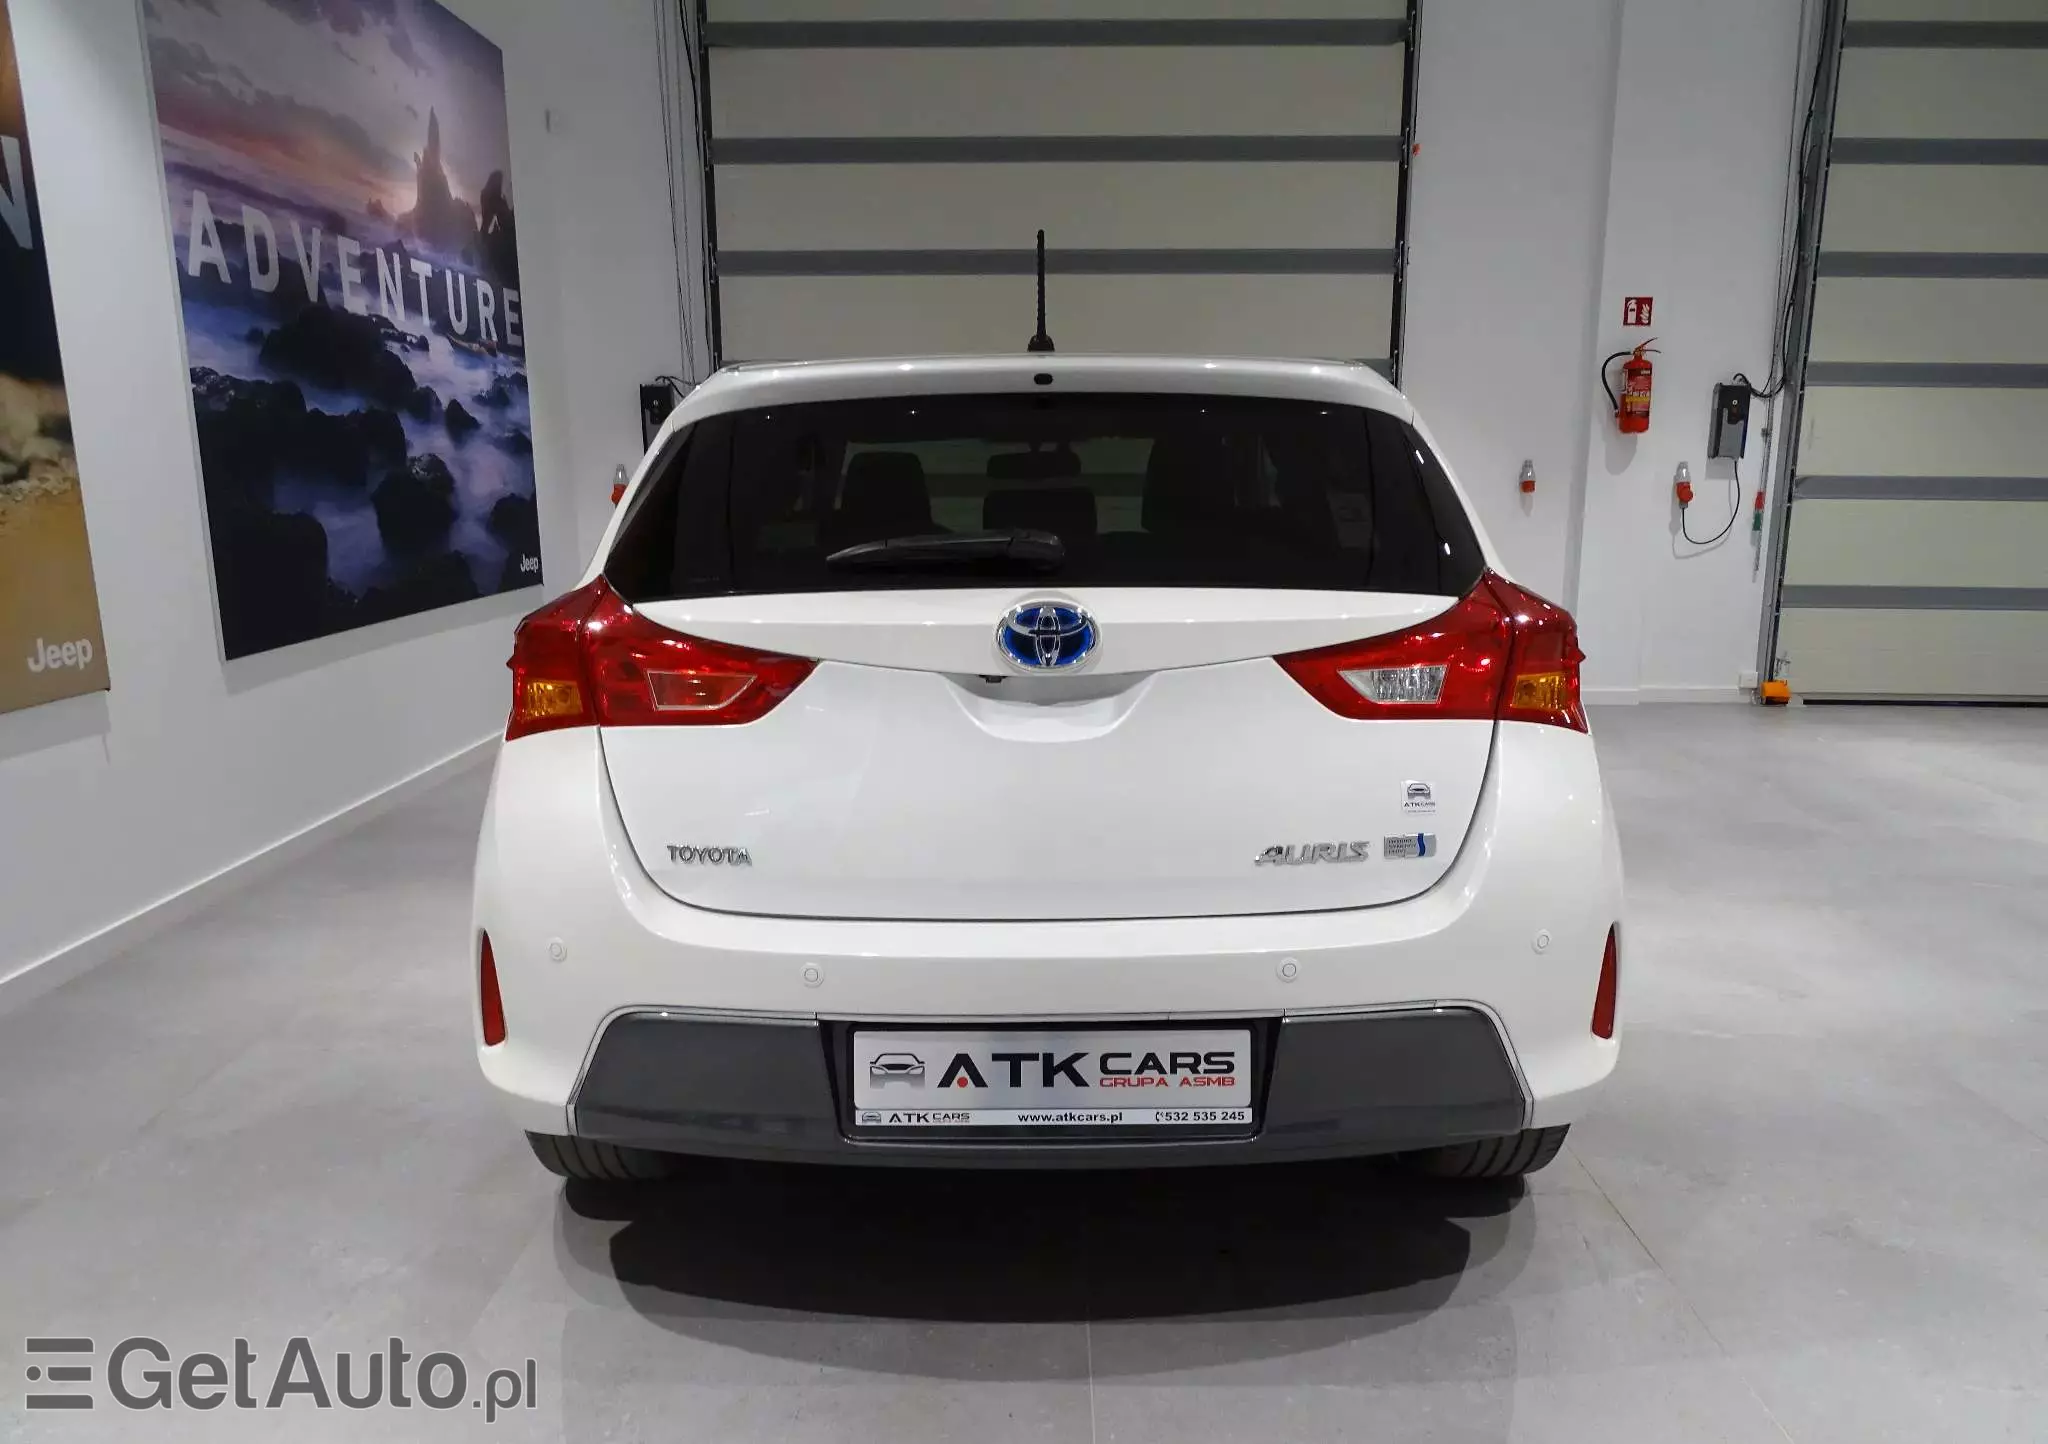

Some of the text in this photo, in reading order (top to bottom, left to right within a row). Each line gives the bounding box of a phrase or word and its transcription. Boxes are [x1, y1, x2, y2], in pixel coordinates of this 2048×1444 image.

[188, 189, 523, 346] ADVENTURE
[521, 553, 538, 573] Jeep
[27, 638, 93, 673] Jeep
[667, 845, 752, 866] TOYOTA
[1254, 841, 1370, 865] AURIS
[937, 1052, 1235, 1088] ATK CARS
[1100, 1076, 1236, 1088] GRUPA ASMB
[889, 1113, 930, 1123] ATK
[932, 1112, 970, 1120] CARS
[1018, 1112, 1123, 1123] www.atkcars.pl
[1165, 1111, 1245, 1121] 532 535 245
